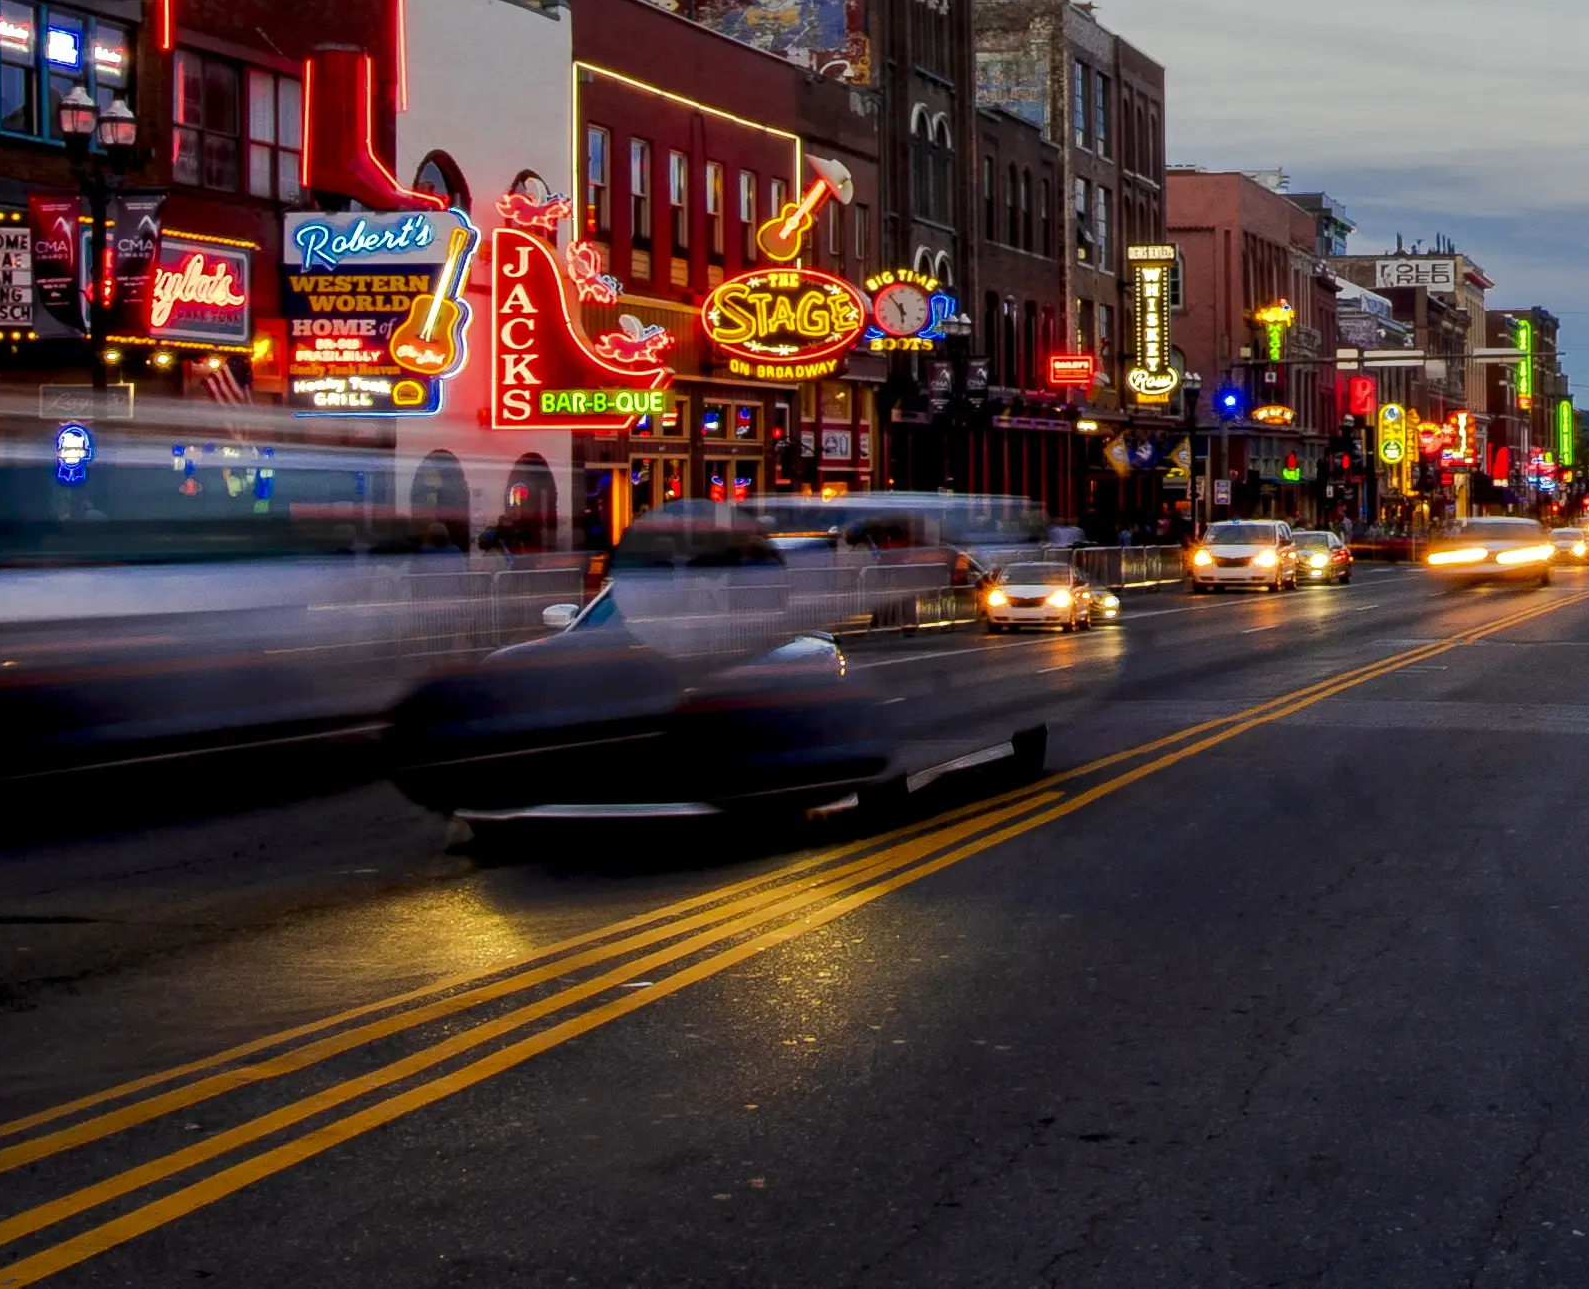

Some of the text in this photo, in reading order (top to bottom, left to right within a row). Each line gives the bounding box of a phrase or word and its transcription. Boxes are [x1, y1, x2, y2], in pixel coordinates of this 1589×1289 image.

[35, 240, 69, 253] CMA
[118, 239, 154, 252] CMA
[297, 215, 434, 272] Robert's
[1395, 263, 1450, 273] OLE
[290, 275, 431, 293] WESTERN
[767, 273, 800, 288] THE
[866, 269, 939, 292] BIG TIME
[1396, 274, 1450, 284] RED
[309, 295, 411, 312] WORLD
[713, 283, 859, 344] STAGE
[1142, 268, 1162, 372] WHISKEY
[292, 317, 396, 339] HOME of
[500, 246, 542, 421] JACKS
[870, 337, 935, 351] BOOTS
[729, 359, 838, 379] ON BROADWAY
[1134, 371, 1172, 388] Row
[540, 391, 664, 414] BAR-B-QUE
